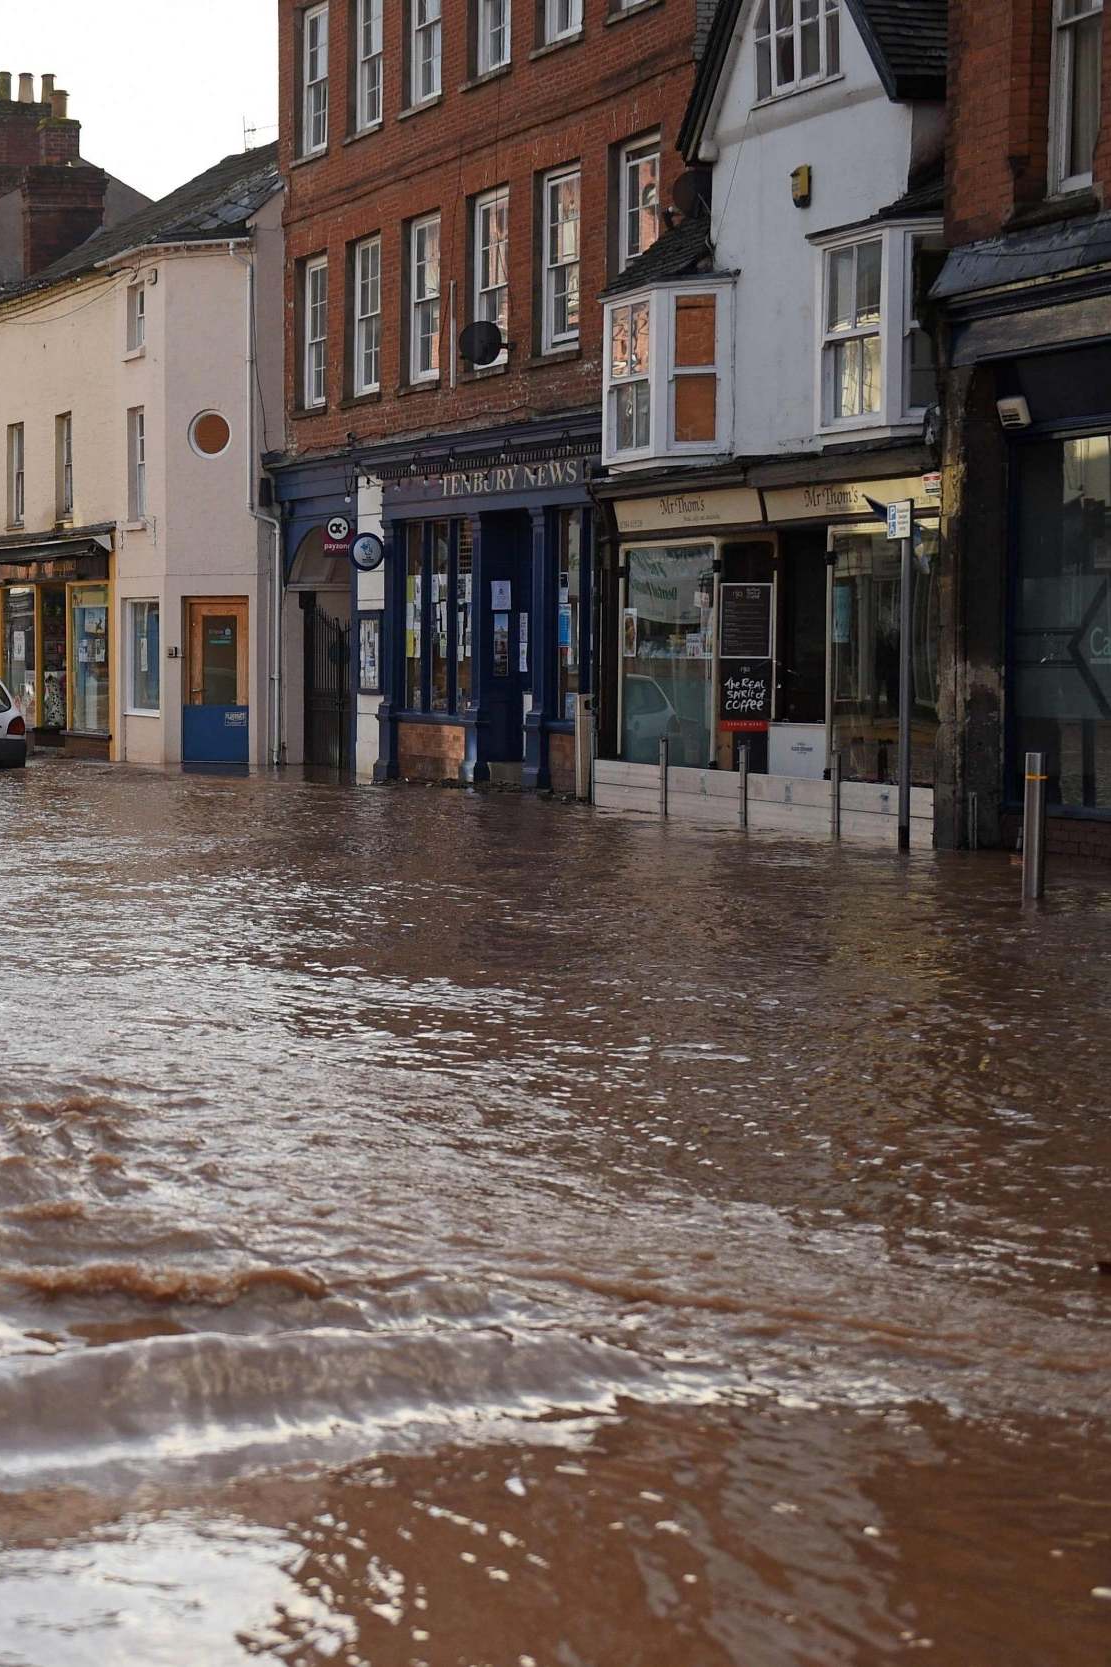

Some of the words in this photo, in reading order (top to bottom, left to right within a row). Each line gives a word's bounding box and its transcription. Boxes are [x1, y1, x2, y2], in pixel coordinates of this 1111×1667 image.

[441, 467, 519, 496] TENBURY
[523, 461, 577, 488] NEWS
[659, 497, 675, 515] Mr
[676, 496, 705, 513] Thom's
[803, 490, 821, 508] Mr
[823, 486, 859, 505] Thom's
